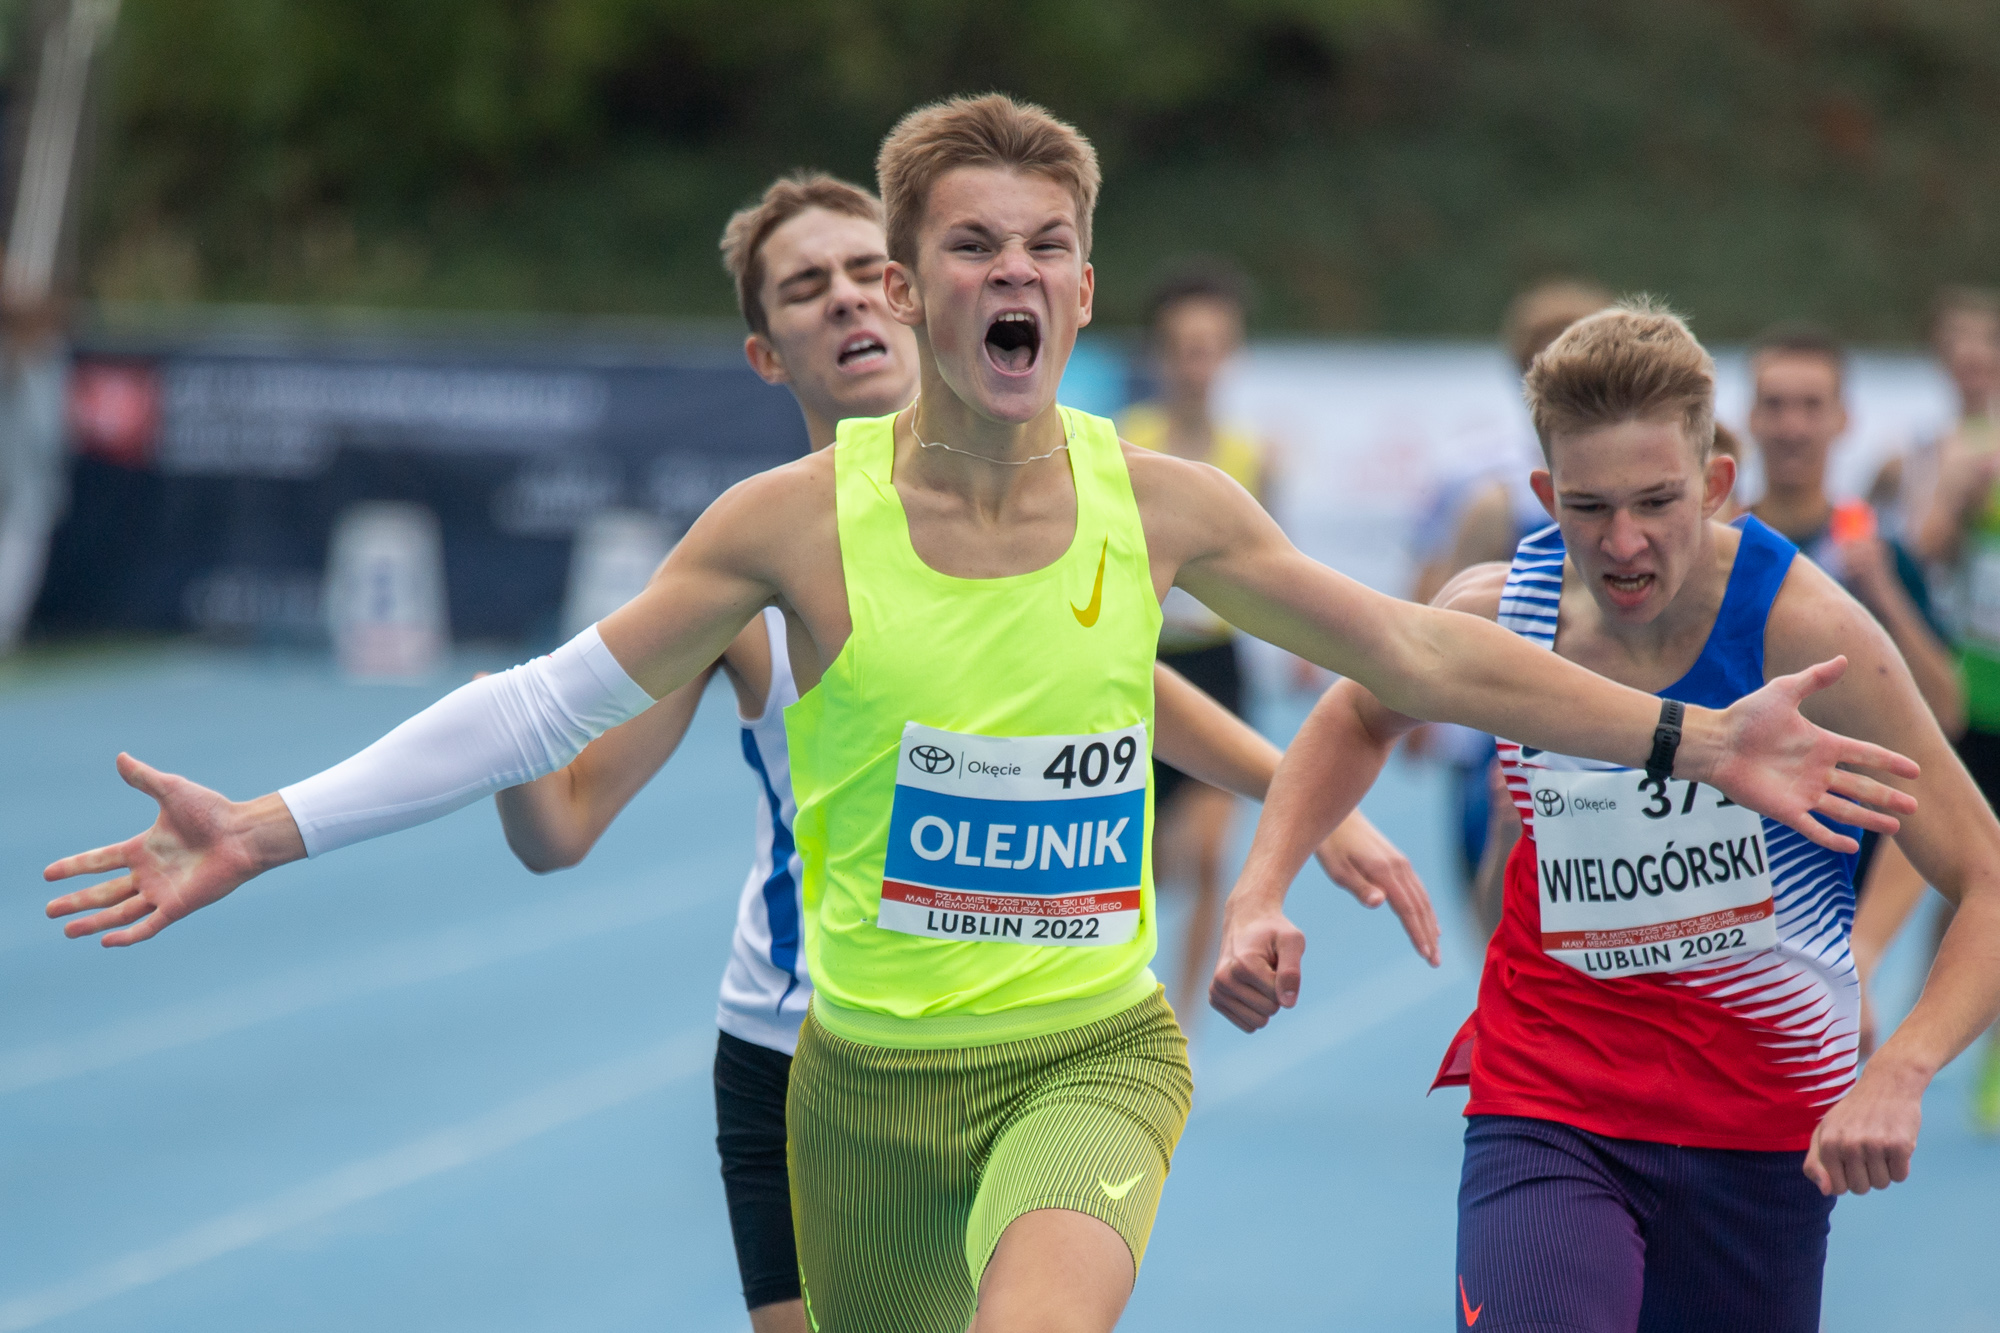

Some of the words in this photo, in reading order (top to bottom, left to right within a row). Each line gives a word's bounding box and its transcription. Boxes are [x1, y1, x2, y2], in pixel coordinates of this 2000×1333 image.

[968, 760, 1021, 776] Okęcie
[1042, 736, 1137, 790] 409
[1574, 798, 1617, 812] Okęcie
[1637, 777, 1736, 820] 37
[909, 815, 1130, 871] OLEJNIK
[1540, 834, 1765, 904] WIELOGÓRSKI
[905, 894, 932, 905] MAŁY
[934, 900, 991, 912] MEMORIAŁ
[994, 906, 1044, 915] JANUSZA
[935, 892, 962, 902] PZLA
[965, 896, 1041, 907] MISTRZOSTWA
[1043, 898, 1078, 908] POLSKI
[1079, 896, 1096, 905] U16
[927, 910, 1023, 937] LUBLIN
[1031, 917, 1100, 939] 2022
[1609, 923, 1679, 939] MISTRZOSTWA
[1680, 914, 1716, 928] POLSKI
[1638, 929, 1685, 944] JANUSZA
[1584, 943, 1672, 972] LUBLIN
[1680, 928, 1747, 960] 2022
